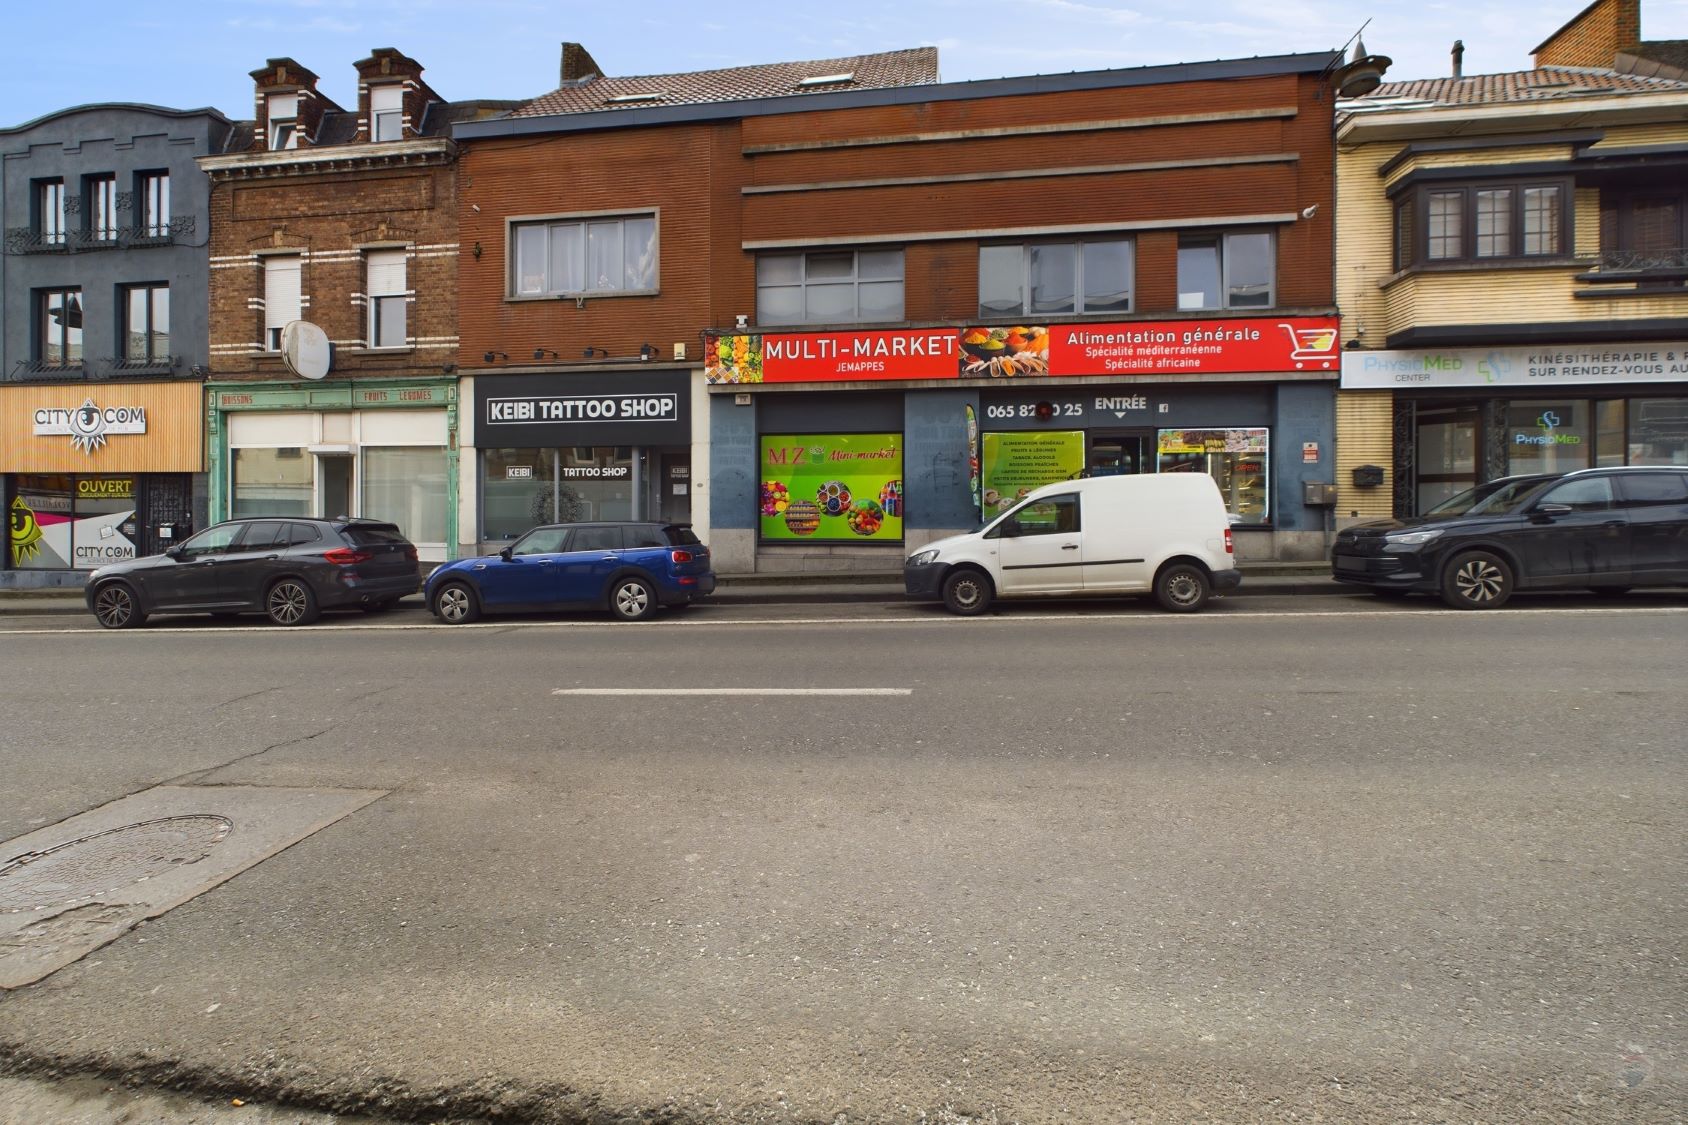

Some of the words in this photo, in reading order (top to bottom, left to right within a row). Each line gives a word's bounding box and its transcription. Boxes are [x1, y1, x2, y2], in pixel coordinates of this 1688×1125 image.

[1067, 329, 1176, 345] Alimentation
[1183, 327, 1261, 344] générale
[766, 335, 957, 360] MULTI-MARKET
[1085, 345, 1134, 358] Spécialité
[1137, 344, 1222, 356] méditerranéenne
[1105, 357, 1153, 371] Spécialité
[1157, 357, 1201, 369] africaine
[1528, 351, 1658, 364] KINÉSITHÉRAPIE
[1666, 352, 1675, 361] &
[836, 361, 885, 373] JEMAPPES
[1528, 367, 1557, 377] SUR
[1562, 364, 1664, 376] RENDEZ-VOUS
[1395, 374, 1431, 382] CENTER
[364, 391, 388, 401] FRUITS
[1095, 394, 1147, 409] ENTRÉE
[491, 402, 535, 420] KEIBI
[539, 400, 616, 419] TATTOO
[620, 398, 673, 417] SHOP
[987, 405, 1015, 418] 065
[1064, 403, 1083, 416] 25
[35, 409, 74, 425] CITY
[104, 407, 144, 424] COM
[508, 467, 530, 477] KEIBI
[563, 467, 600, 477] TATTOO
[602, 467, 627, 477] SHOP
[79, 480, 132, 493] OUVERT
[76, 546, 103, 557] CITY
[106, 546, 133, 558] COM
